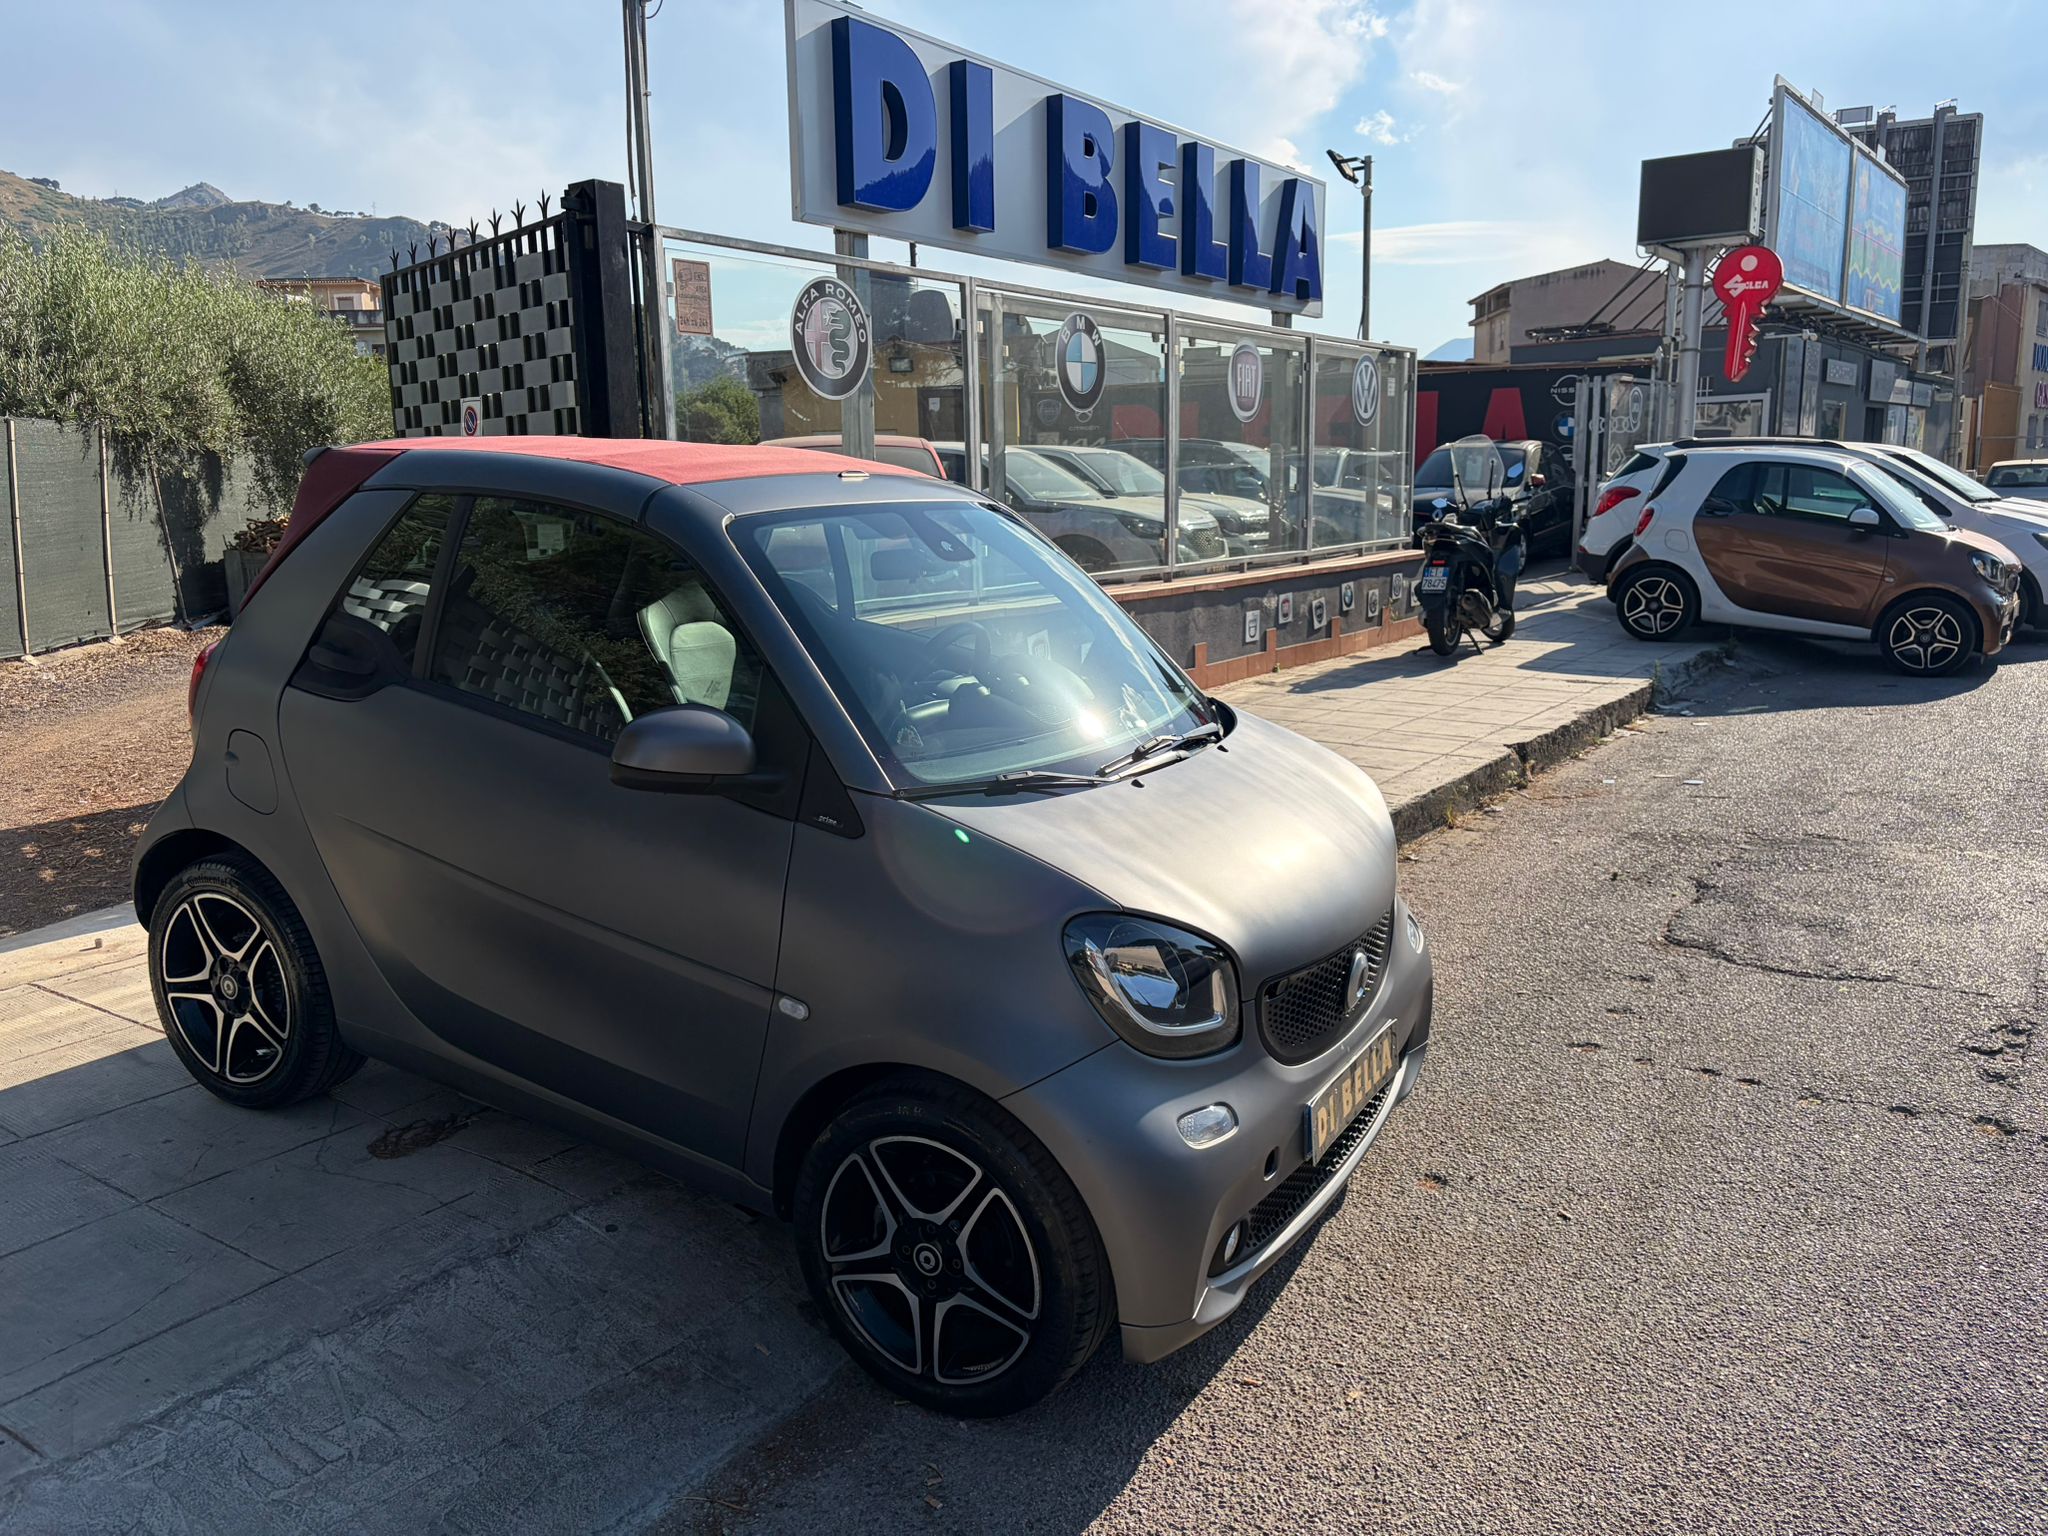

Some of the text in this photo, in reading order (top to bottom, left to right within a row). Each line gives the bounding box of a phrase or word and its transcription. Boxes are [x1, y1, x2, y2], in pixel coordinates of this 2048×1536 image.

[831, 15, 1323, 301] DI BELLA
[794, 283, 867, 344] ALFA ROMEO
[1061, 315, 1101, 347] BMW
[1237, 363, 1257, 398] FIAT
[1317, 1038, 1393, 1148] DI BELLA
